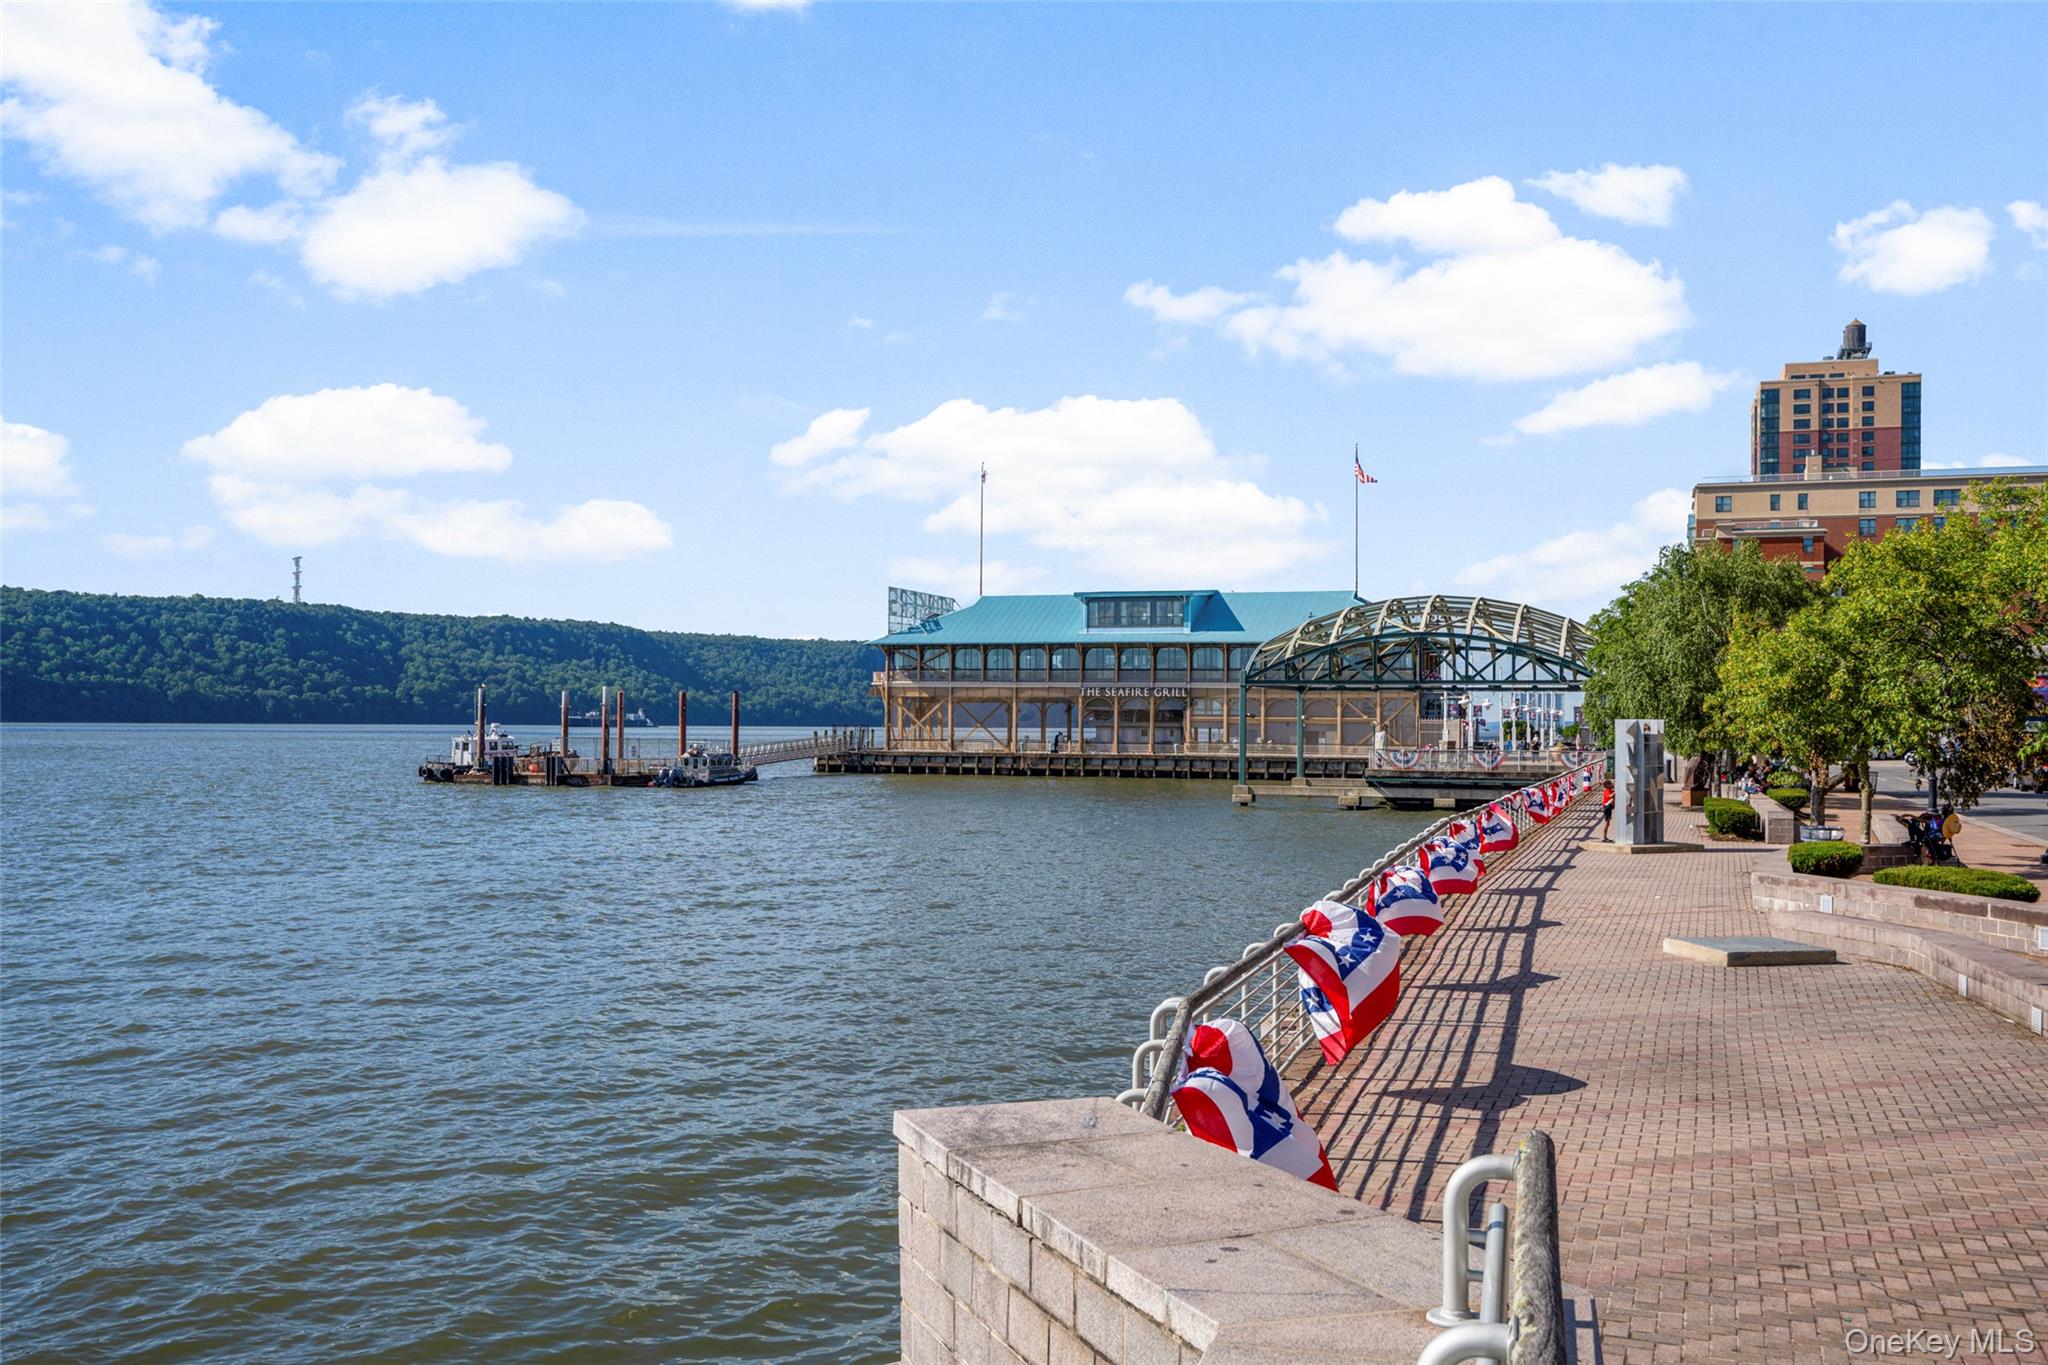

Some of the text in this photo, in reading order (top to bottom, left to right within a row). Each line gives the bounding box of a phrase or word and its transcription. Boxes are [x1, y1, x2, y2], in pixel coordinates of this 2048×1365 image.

[1080, 687, 1188, 697] THE SEAFIRE GRILL
